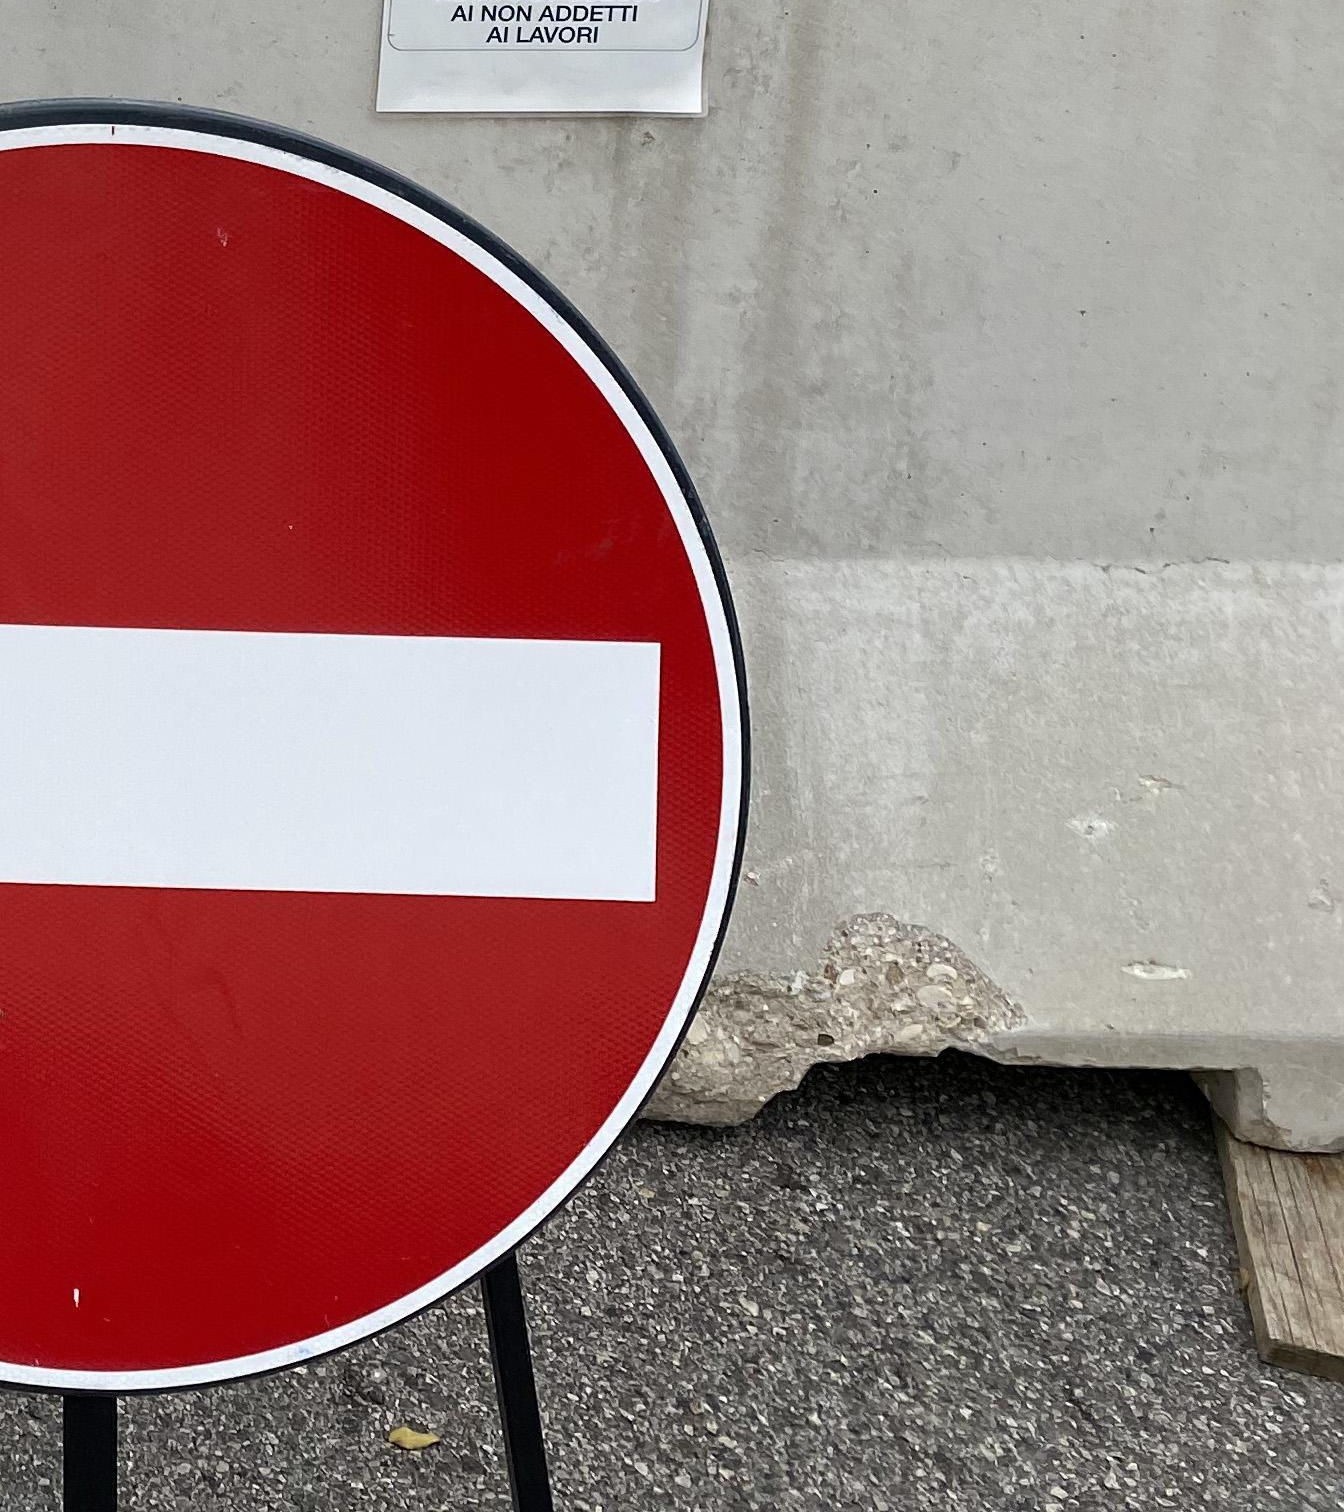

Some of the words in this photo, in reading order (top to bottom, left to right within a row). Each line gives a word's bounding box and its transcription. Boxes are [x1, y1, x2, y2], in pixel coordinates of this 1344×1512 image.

[450, 4, 474, 22] AI
[480, 4, 533, 22] NON
[537, 5, 639, 22] ADDETTI
[485, 26, 509, 44] AI
[516, 26, 599, 44] LAVORI
